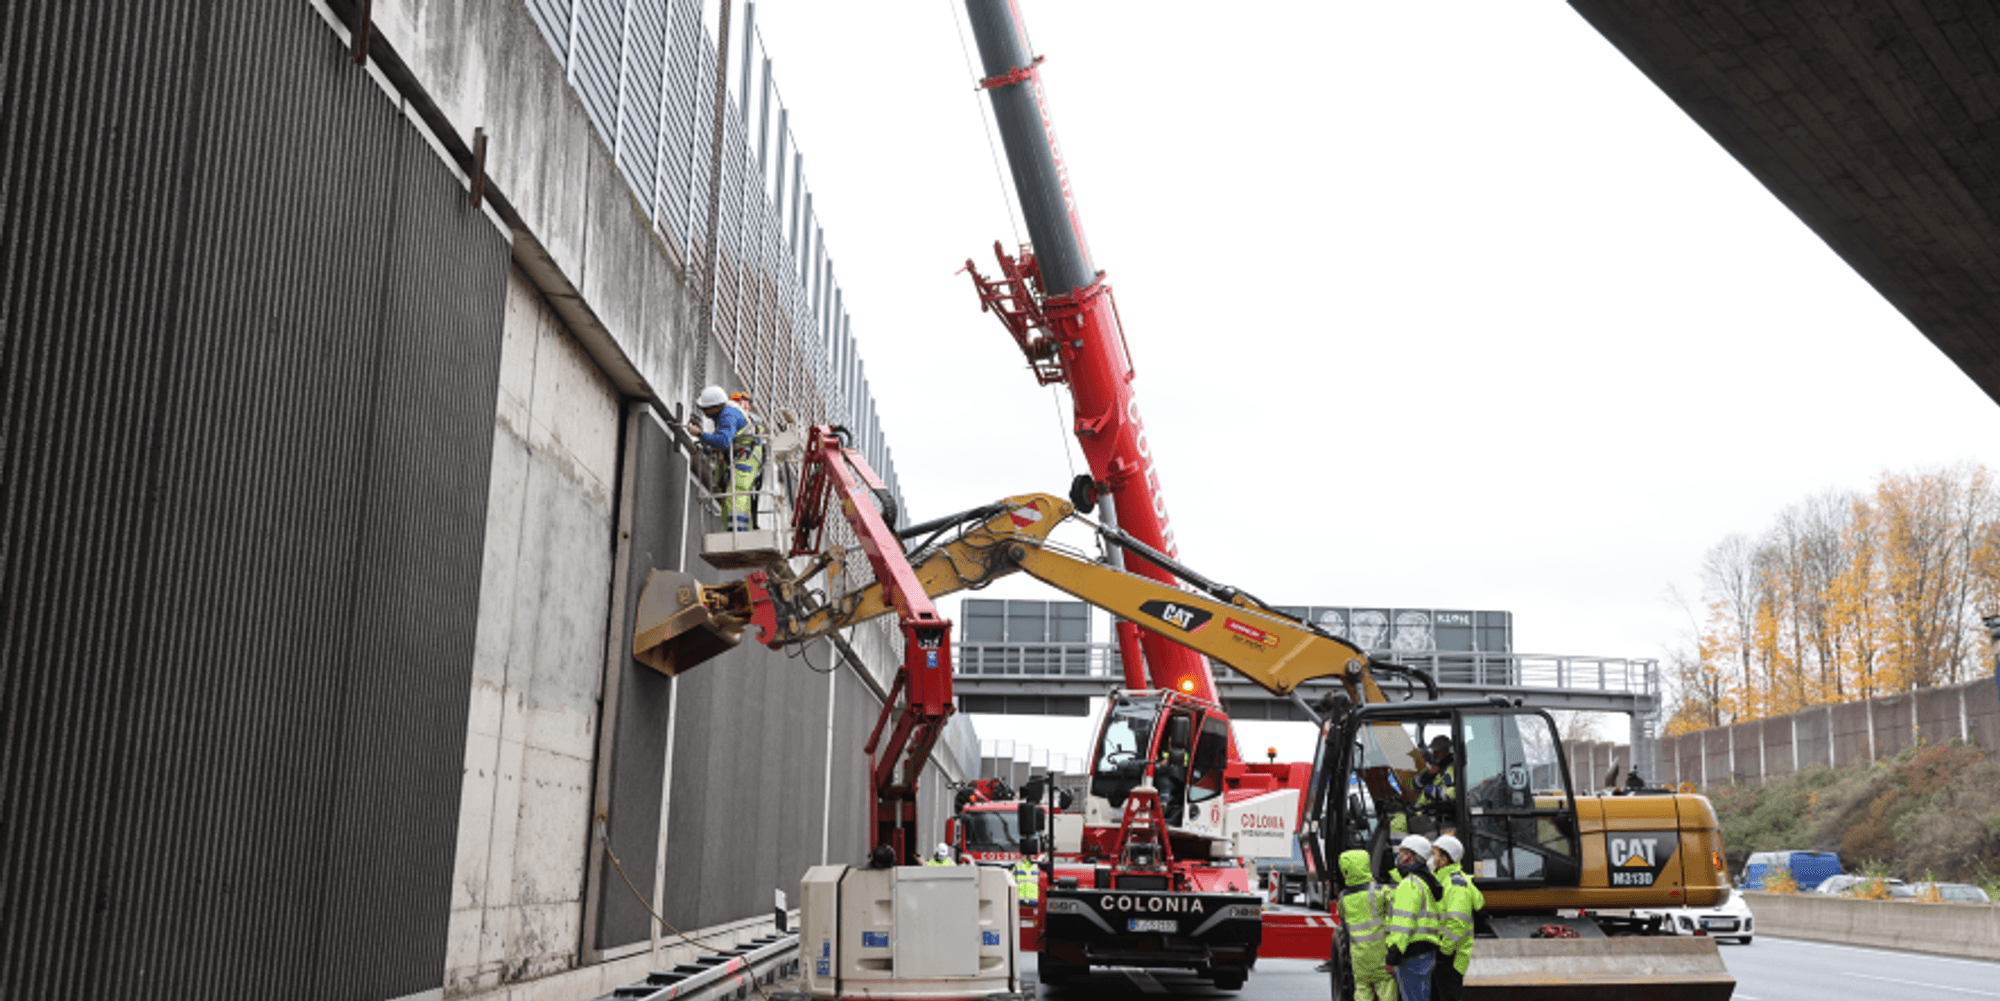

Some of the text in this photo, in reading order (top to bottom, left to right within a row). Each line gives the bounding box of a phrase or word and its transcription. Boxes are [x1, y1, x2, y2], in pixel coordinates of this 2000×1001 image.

[1163, 604, 1194, 629] CAT
[1241, 813, 1285, 829] COLONIA
[1611, 838, 1658, 867] CAT
[1613, 872, 1653, 885] M313D
[1100, 895, 1204, 913] COLONIA
